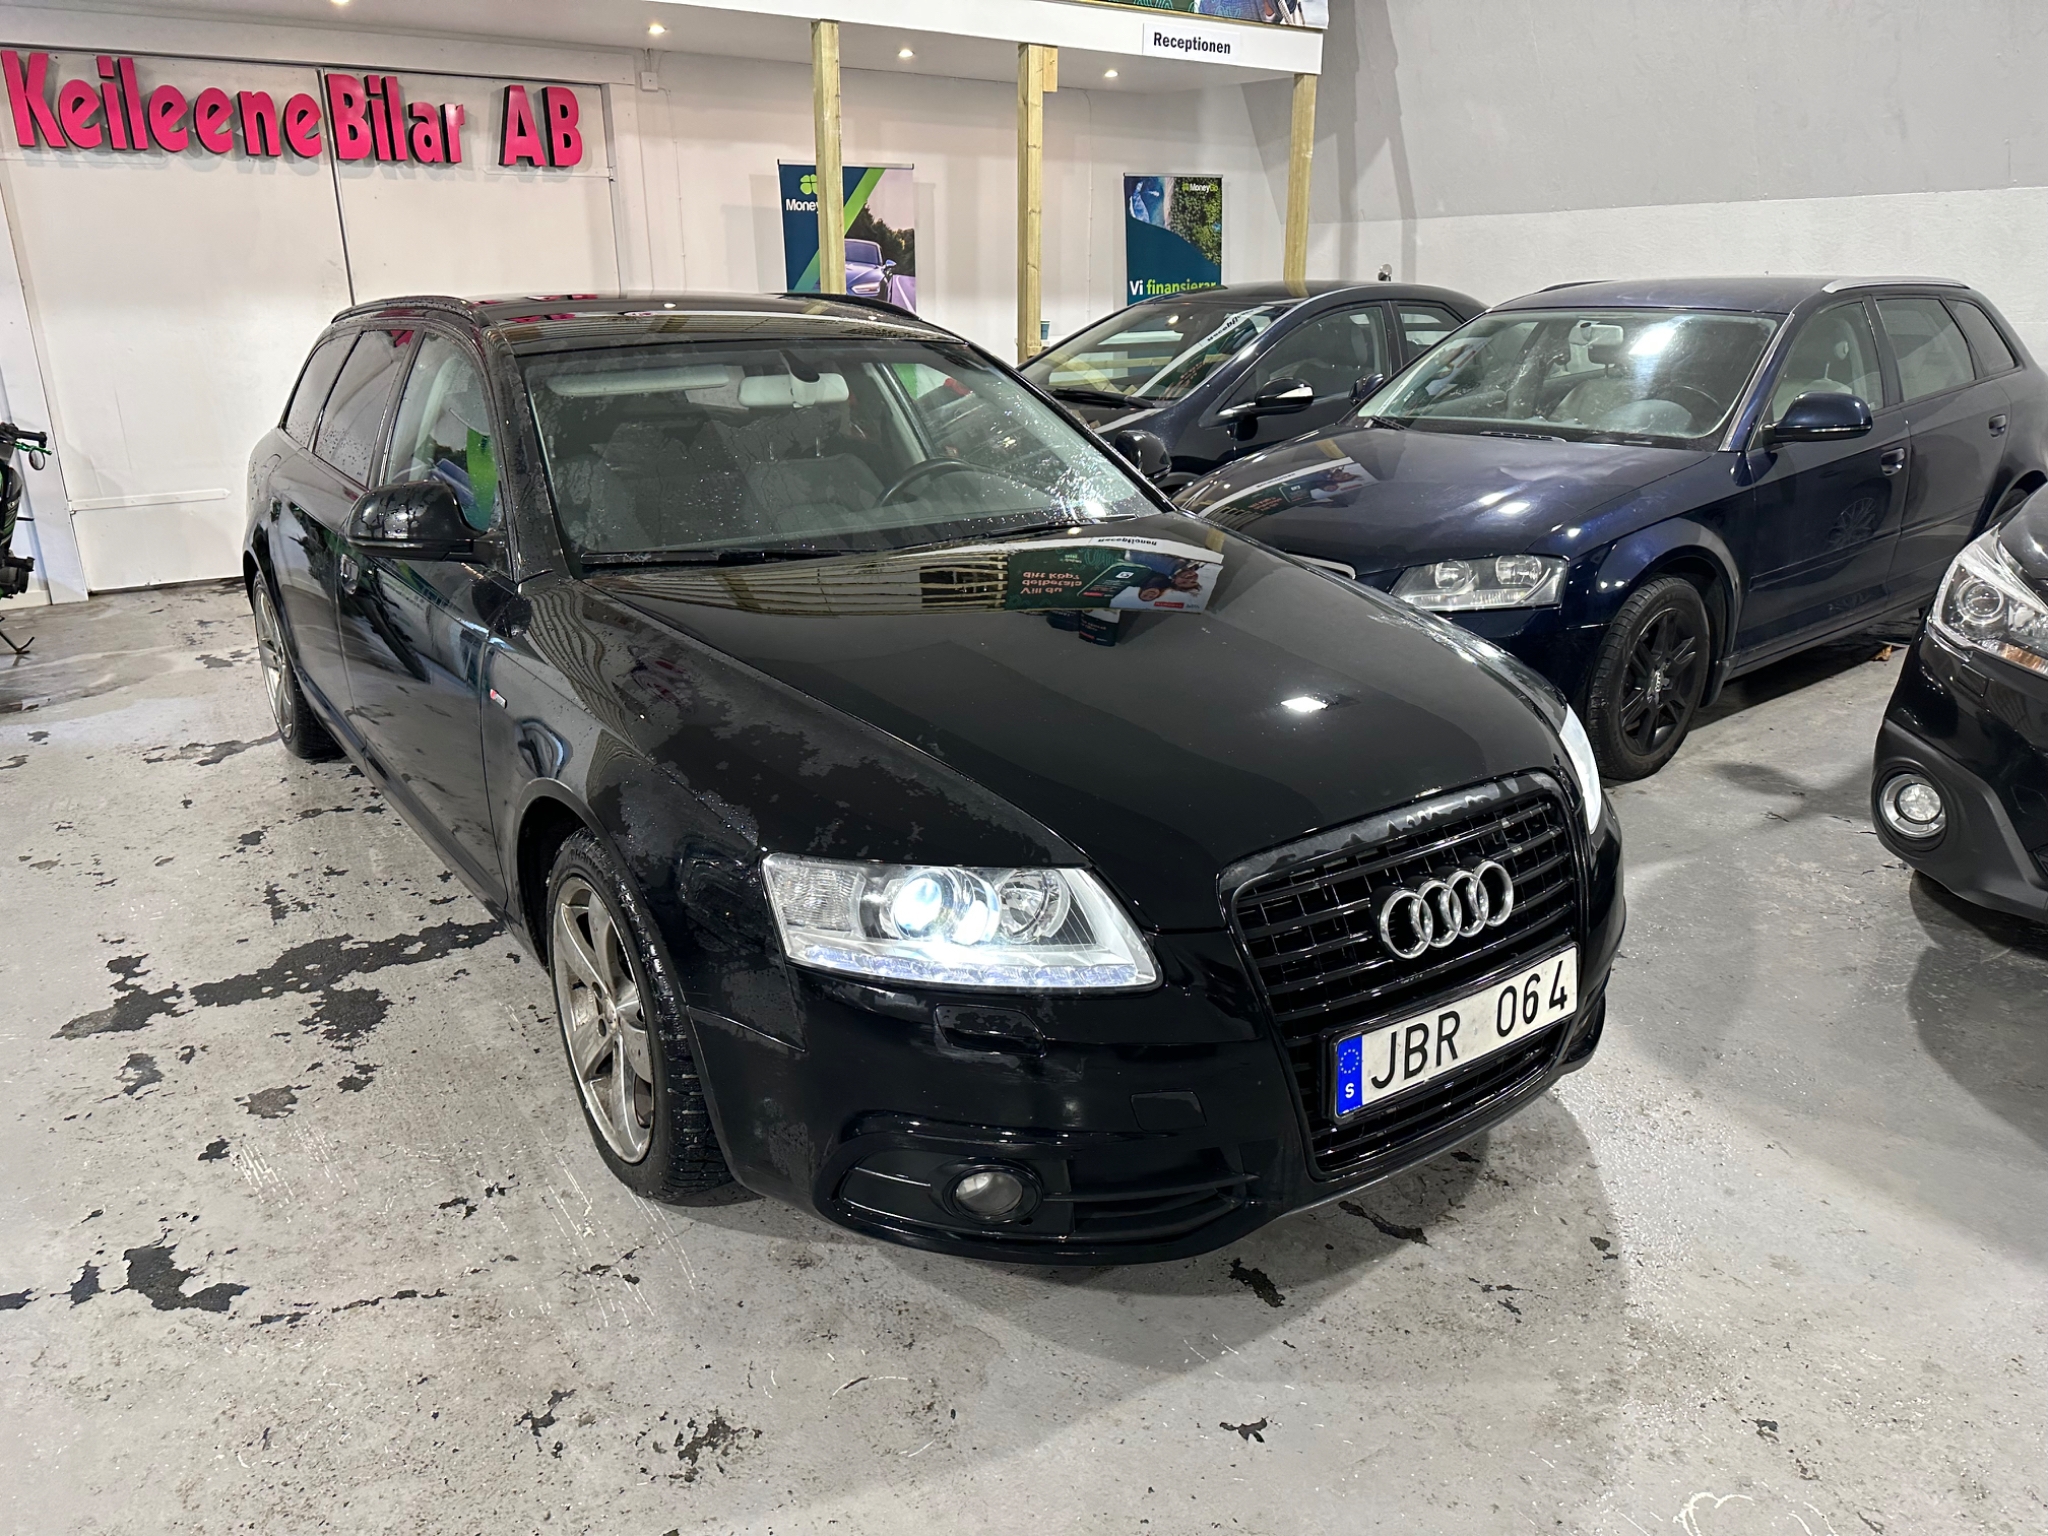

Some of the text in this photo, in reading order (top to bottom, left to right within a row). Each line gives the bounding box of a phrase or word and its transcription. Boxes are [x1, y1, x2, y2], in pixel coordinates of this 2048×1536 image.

[1153, 31, 1231, 54] Receptionen
[499, 84, 583, 167] AB
[1189, 183, 1218, 193] MoneyGo
[1129, 279, 1144, 296] Vi
[1370, 959, 1568, 1091] JBR 064
[1344, 1082, 1355, 1099] S
